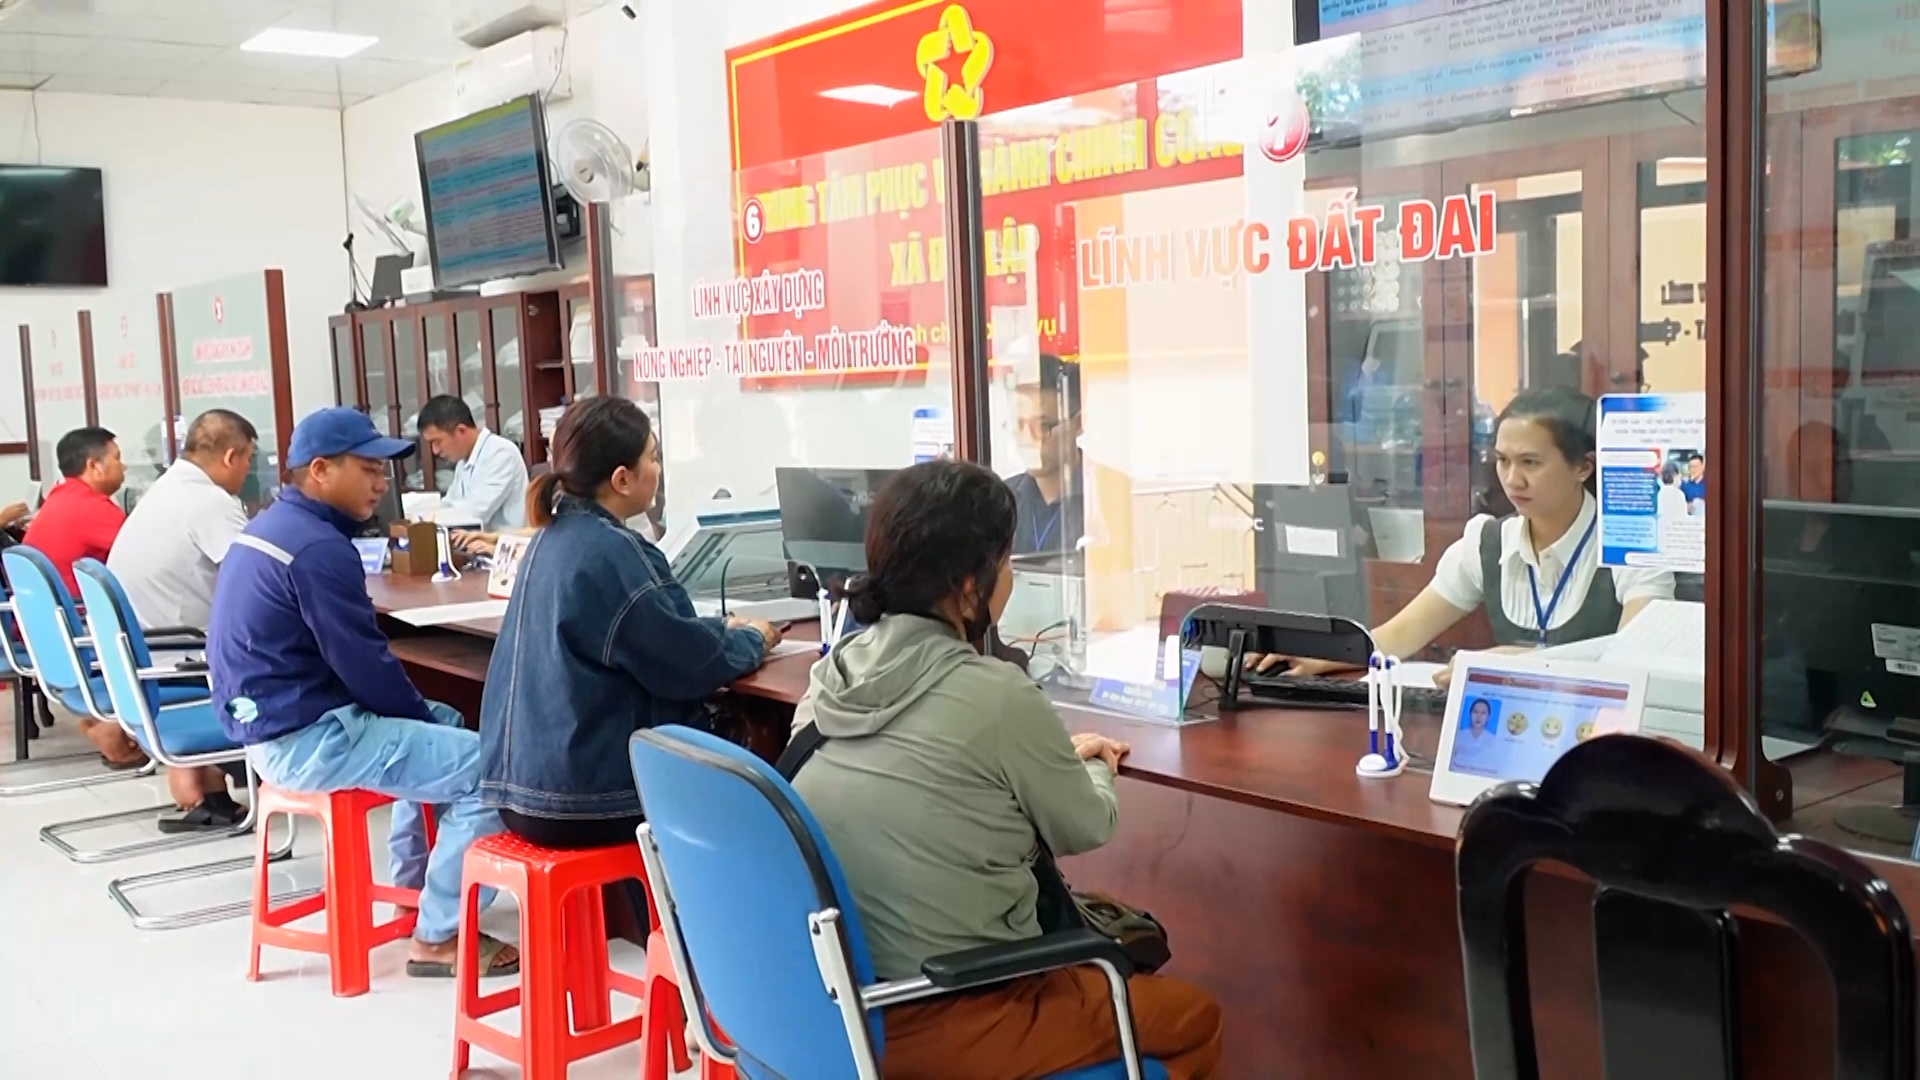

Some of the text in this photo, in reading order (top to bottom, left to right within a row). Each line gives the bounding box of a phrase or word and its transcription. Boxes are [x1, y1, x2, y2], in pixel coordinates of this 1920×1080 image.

[865, 161, 928, 220] PHỤC
[745, 201, 761, 238] 6
[1078, 187, 1497, 291] LĨNH VỰC ĐẤT ĐAI
[889, 231, 927, 287] XÃ
[724, 278, 751, 323] VỰC
[752, 270, 781, 313] XÂY
[782, 267, 825, 319] DỰNG
[748, 329, 804, 376] NGUYÊN
[816, 326, 847, 372] MÔI
[849, 319, 916, 370] TRƯỜNG
